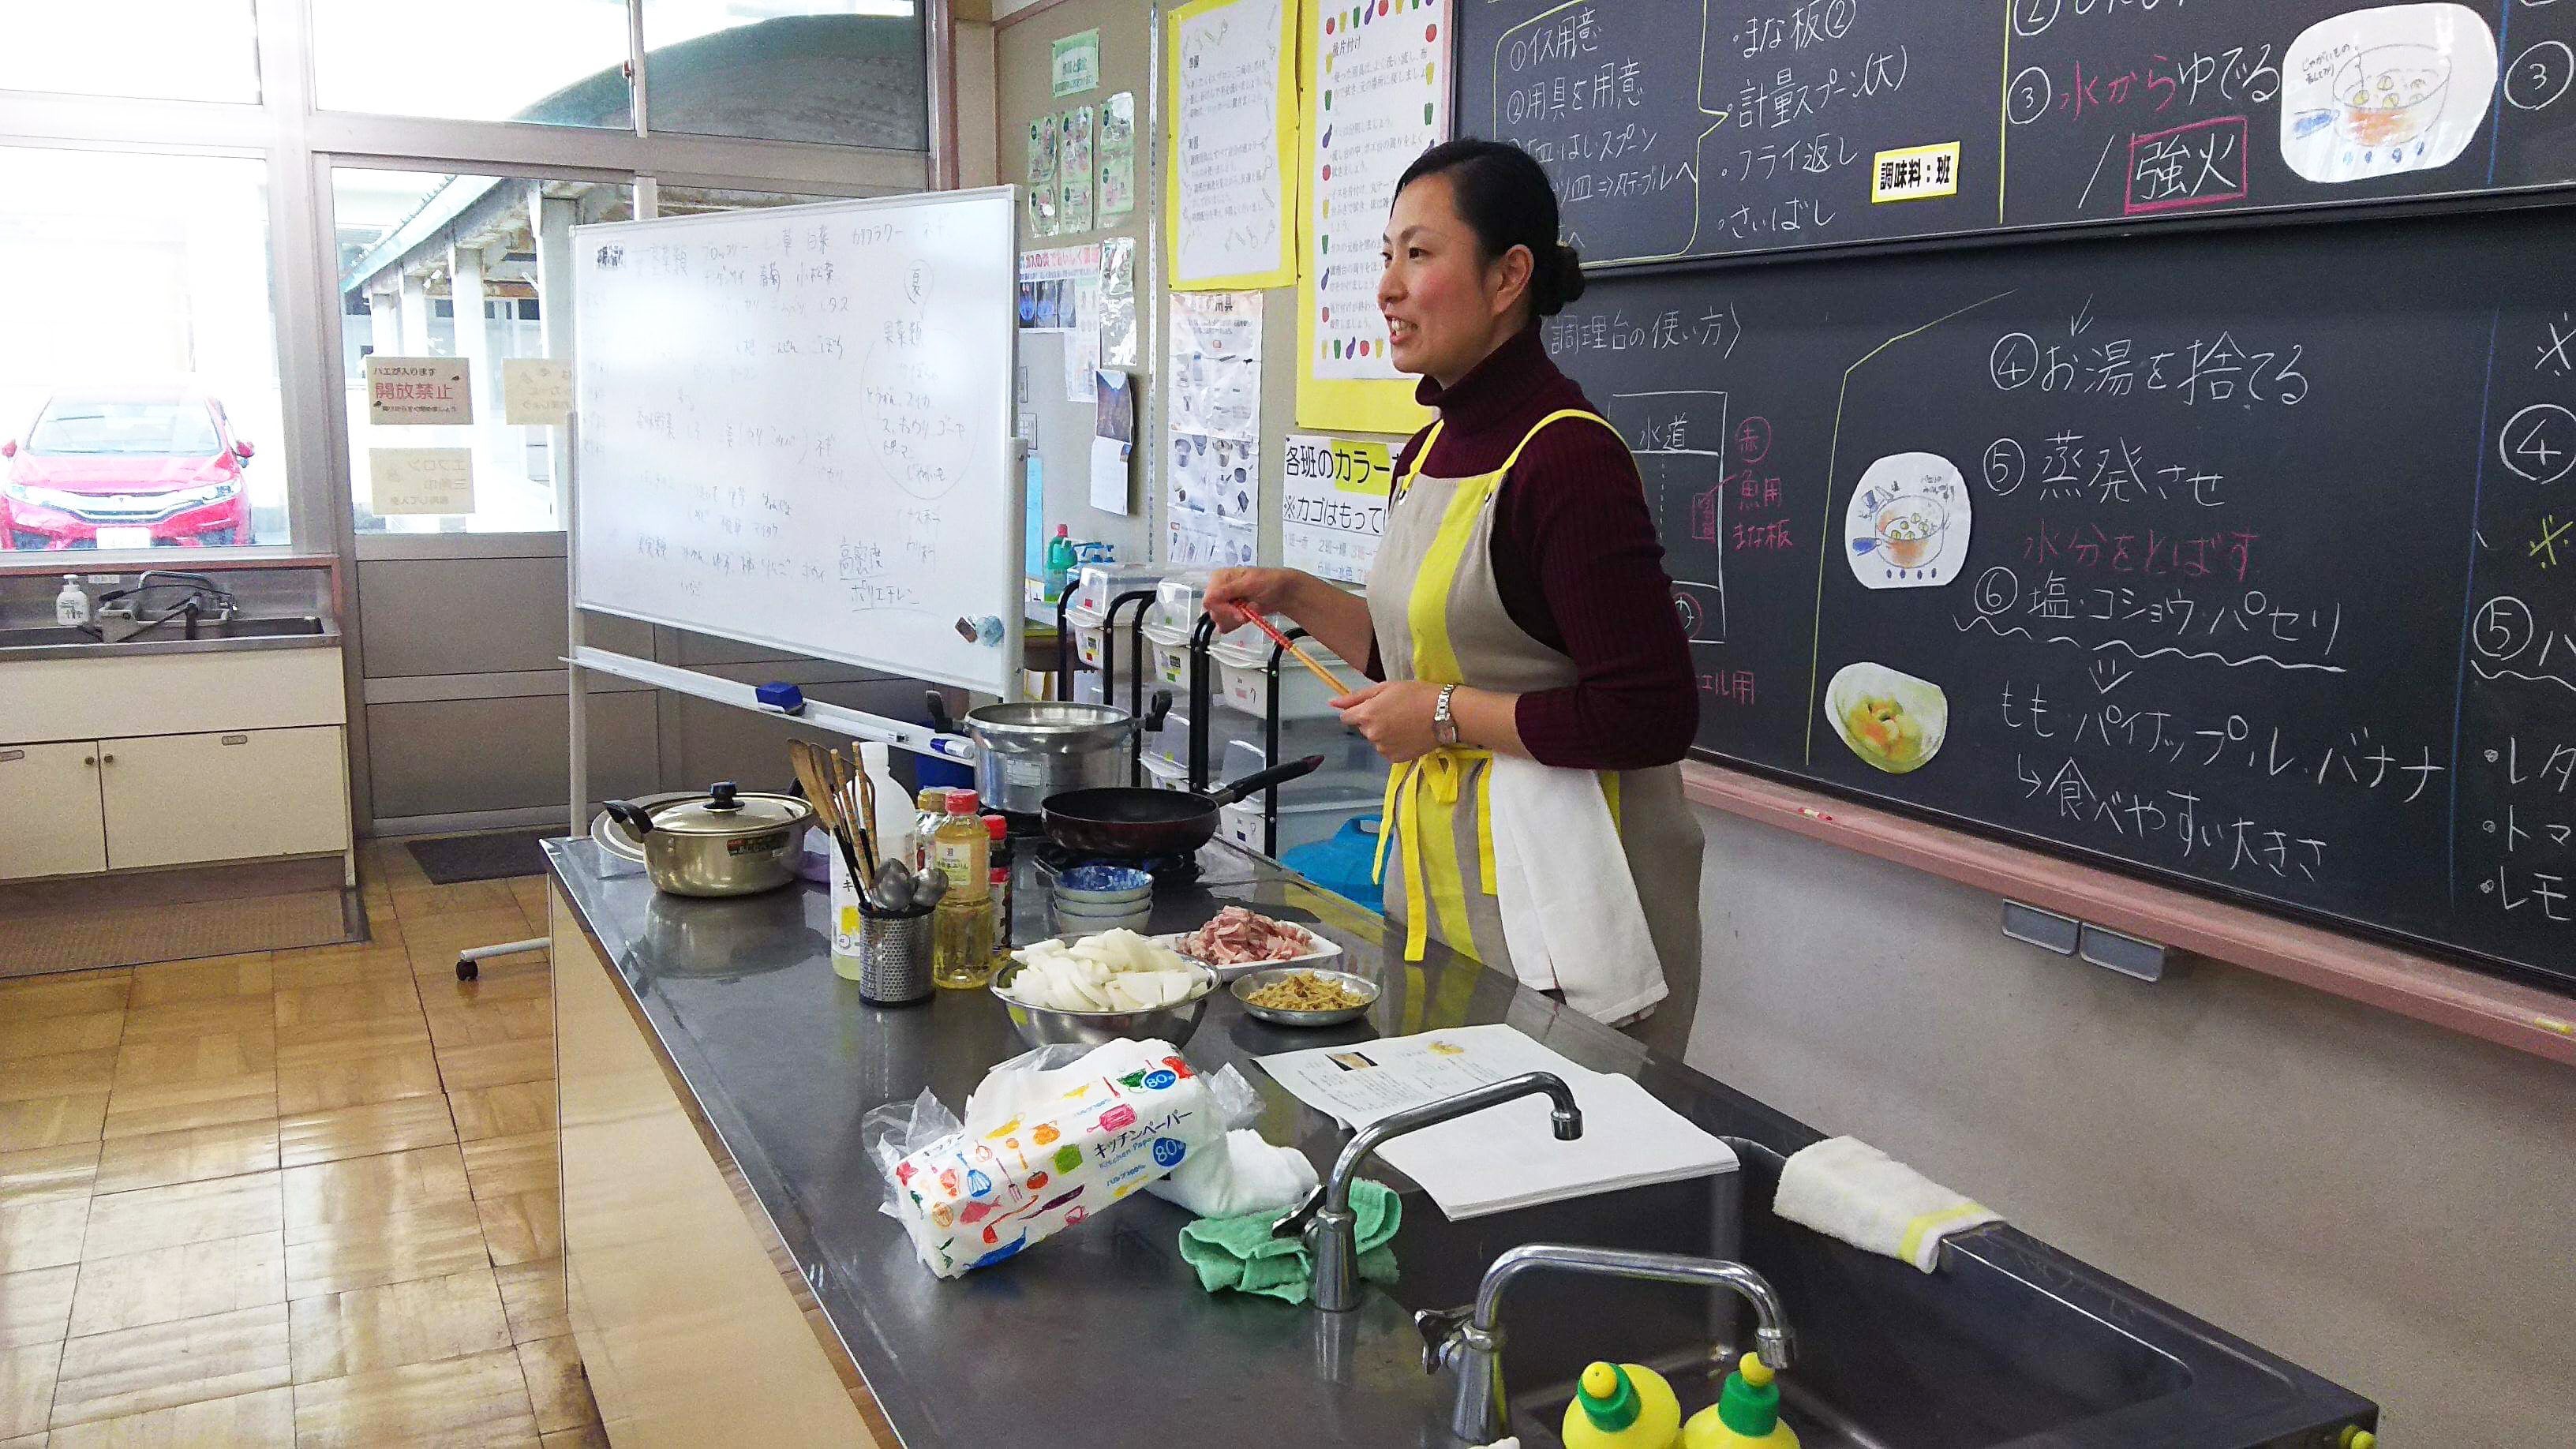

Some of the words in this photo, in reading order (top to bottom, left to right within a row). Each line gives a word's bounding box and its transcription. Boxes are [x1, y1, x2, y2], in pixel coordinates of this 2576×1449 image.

[375, 381, 454, 400] 開放禁止
[1094, 1109, 1193, 1159] キッチンペーパー
